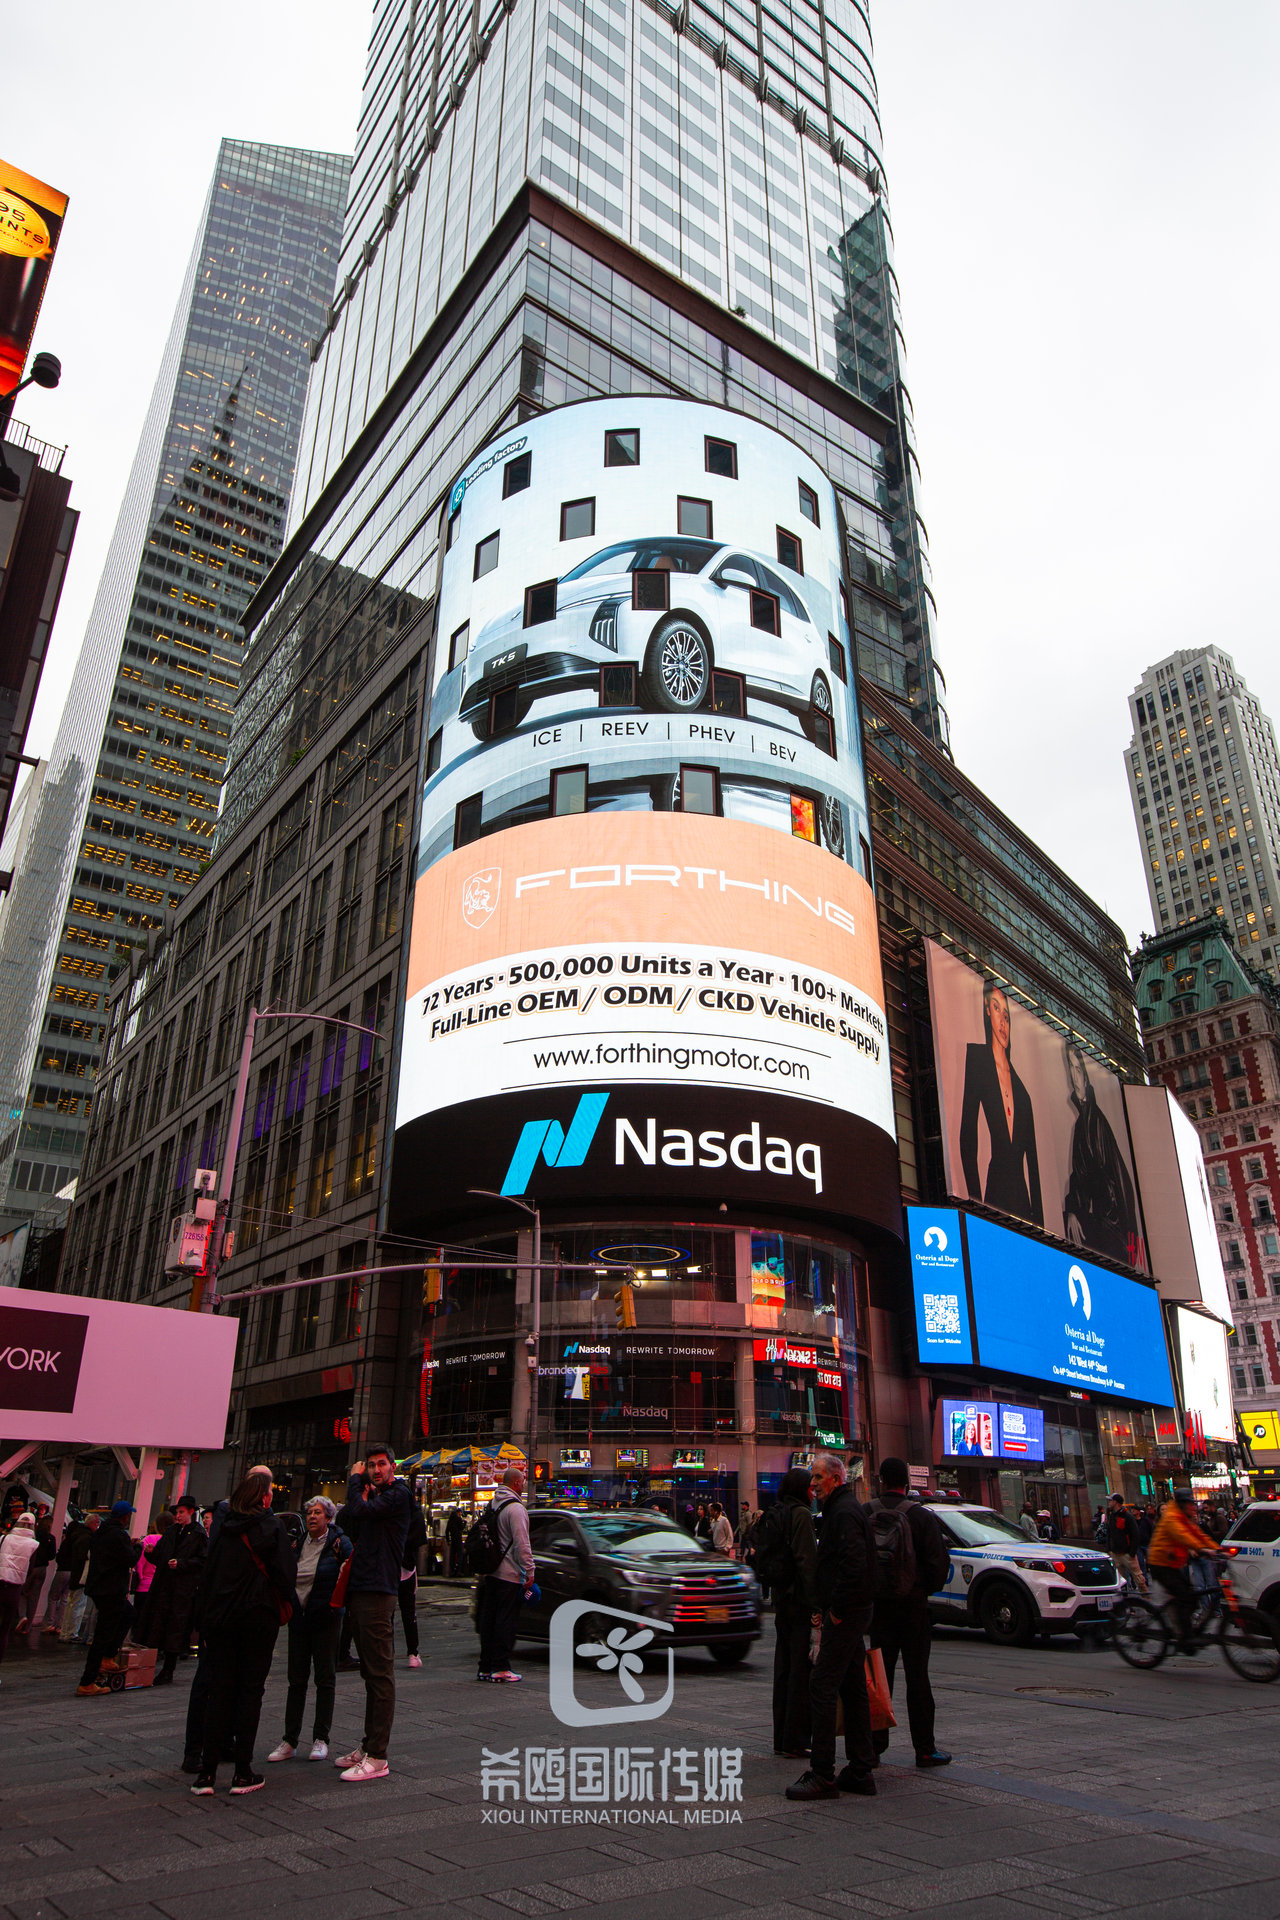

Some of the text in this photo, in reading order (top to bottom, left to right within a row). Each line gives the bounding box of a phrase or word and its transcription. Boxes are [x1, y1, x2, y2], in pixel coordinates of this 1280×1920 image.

[465, 438, 527, 487] Leading factory
[533, 721, 797, 762] ICE REEV PHEV BEV
[515, 864, 856, 936] FORTHING
[422, 955, 884, 1036] 72 Years 500,000 Units a Year 100+ Markets
[431, 1002, 512, 1039] Full-Line
[517, 988, 579, 1013] OEM
[603, 986, 673, 1005] ODM
[698, 988, 755, 1012] CKD
[760, 996, 836, 1033] Vehicle
[839, 1019, 880, 1061] Supply
[533, 1043, 810, 1081] www.forthingmotor.com
[615, 1117, 823, 1195] Nasdaq
[579, 1345, 611, 1356] Nasdaq
[668, 1347, 715, 1356] TOMORROW
[1065, 1323, 1105, 1349] Osteria al Doge
[446, 1356, 467, 1365] REWRITE
[470, 1352, 505, 1362] TOMORROW
[623, 1405, 668, 1420] Nasdaq
[1254, 1427, 1266, 1436] JD
[983, 1553, 1005, 1561] POLICE
